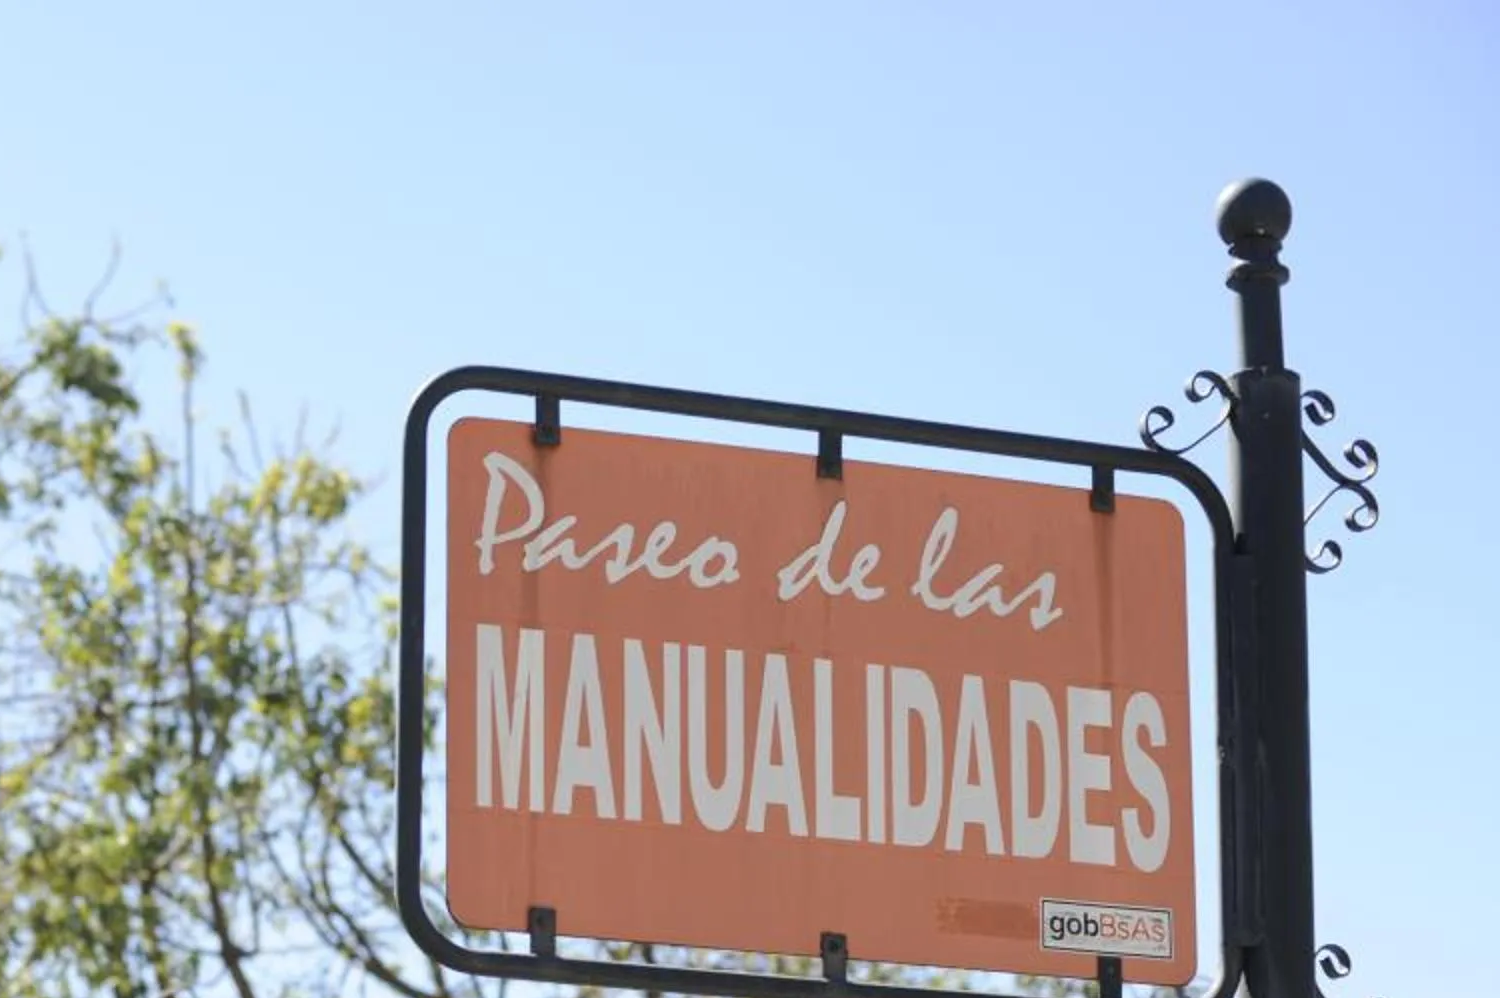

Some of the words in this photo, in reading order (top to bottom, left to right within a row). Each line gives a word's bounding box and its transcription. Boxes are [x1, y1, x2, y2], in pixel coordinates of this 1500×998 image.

[476, 451, 741, 589] Paseo
[778, 501, 886, 602] de
[911, 507, 1064, 630] las
[476, 623, 1172, 873] MANUALIDADES
